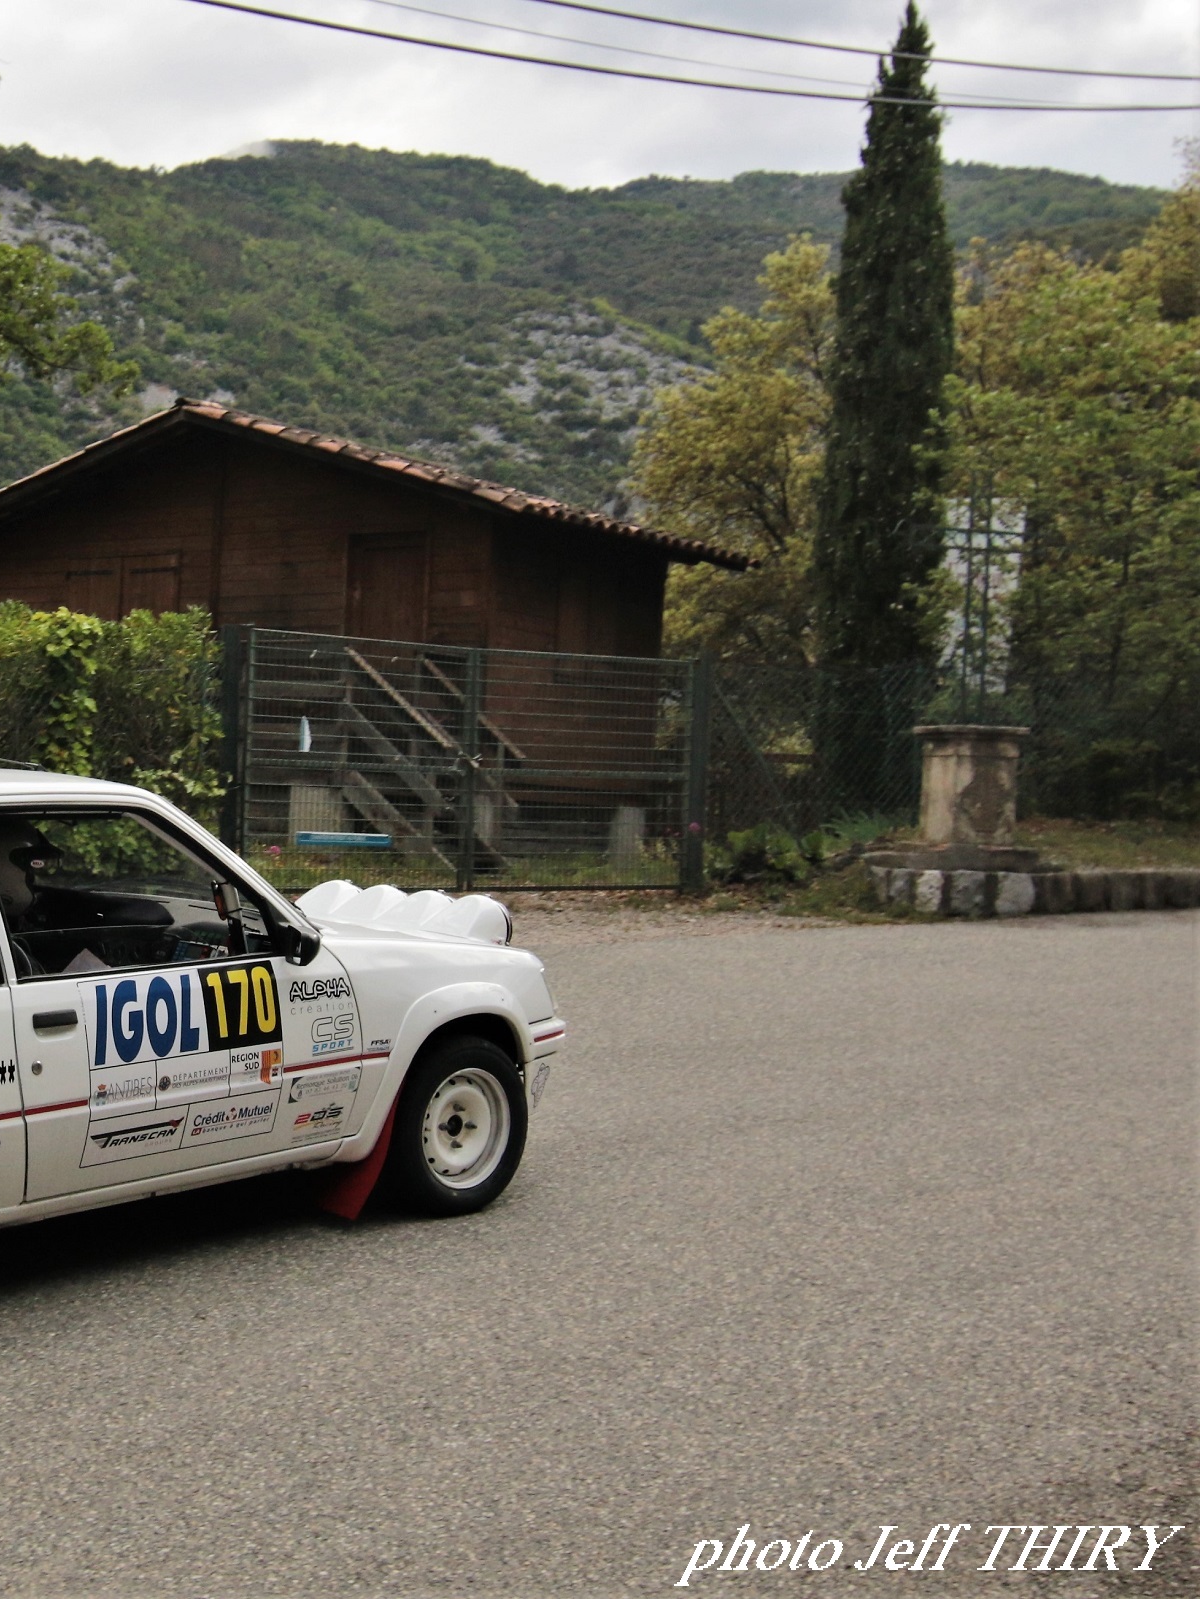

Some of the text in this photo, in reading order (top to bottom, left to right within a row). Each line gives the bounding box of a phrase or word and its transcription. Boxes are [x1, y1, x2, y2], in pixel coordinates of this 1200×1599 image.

[289, 977, 351, 1002] ALPHA
[205, 965, 277, 1039] 170
[94, 974, 200, 1066] IGOL
[310, 1013, 355, 1044] CS
[312, 1038, 353, 1053] SPORT
[172, 1066, 229, 1082] DÉPARTEMENT
[244, 1061, 260, 1072] SUD
[106, 1077, 153, 1100] ANTIBES
[326, 1074, 350, 1085] Solution
[193, 1103, 273, 1127] Crédit Mutuel
[294, 1106, 344, 1126] 205
[202, 1125, 227, 1135] banque
[248, 1117, 270, 1127] parler
